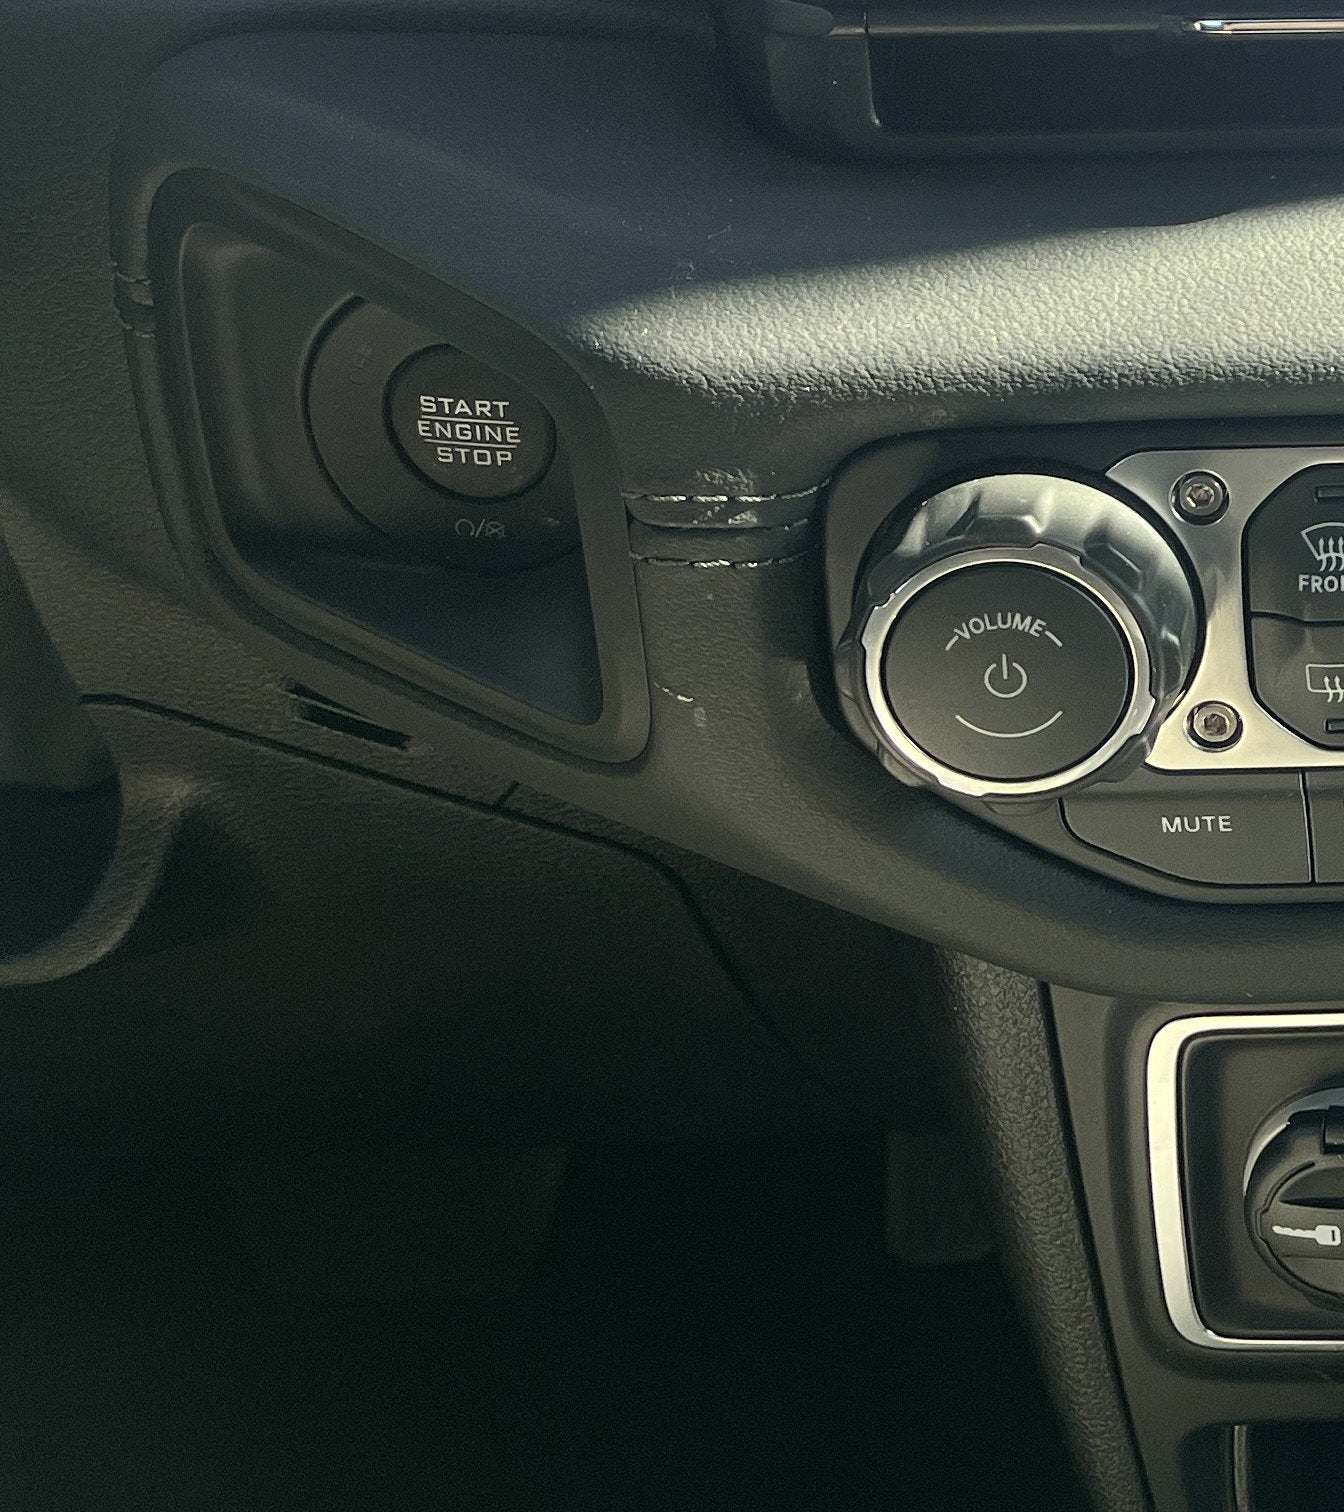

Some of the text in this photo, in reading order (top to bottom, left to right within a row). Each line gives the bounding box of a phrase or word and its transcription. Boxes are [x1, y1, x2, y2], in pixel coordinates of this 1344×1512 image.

[420, 395, 510, 418] START
[417, 419, 521, 443] ENGINE
[437, 446, 513, 467] STOP
[954, 612, 1047, 640] VOLUME
[1162, 814, 1233, 834] MUTE
